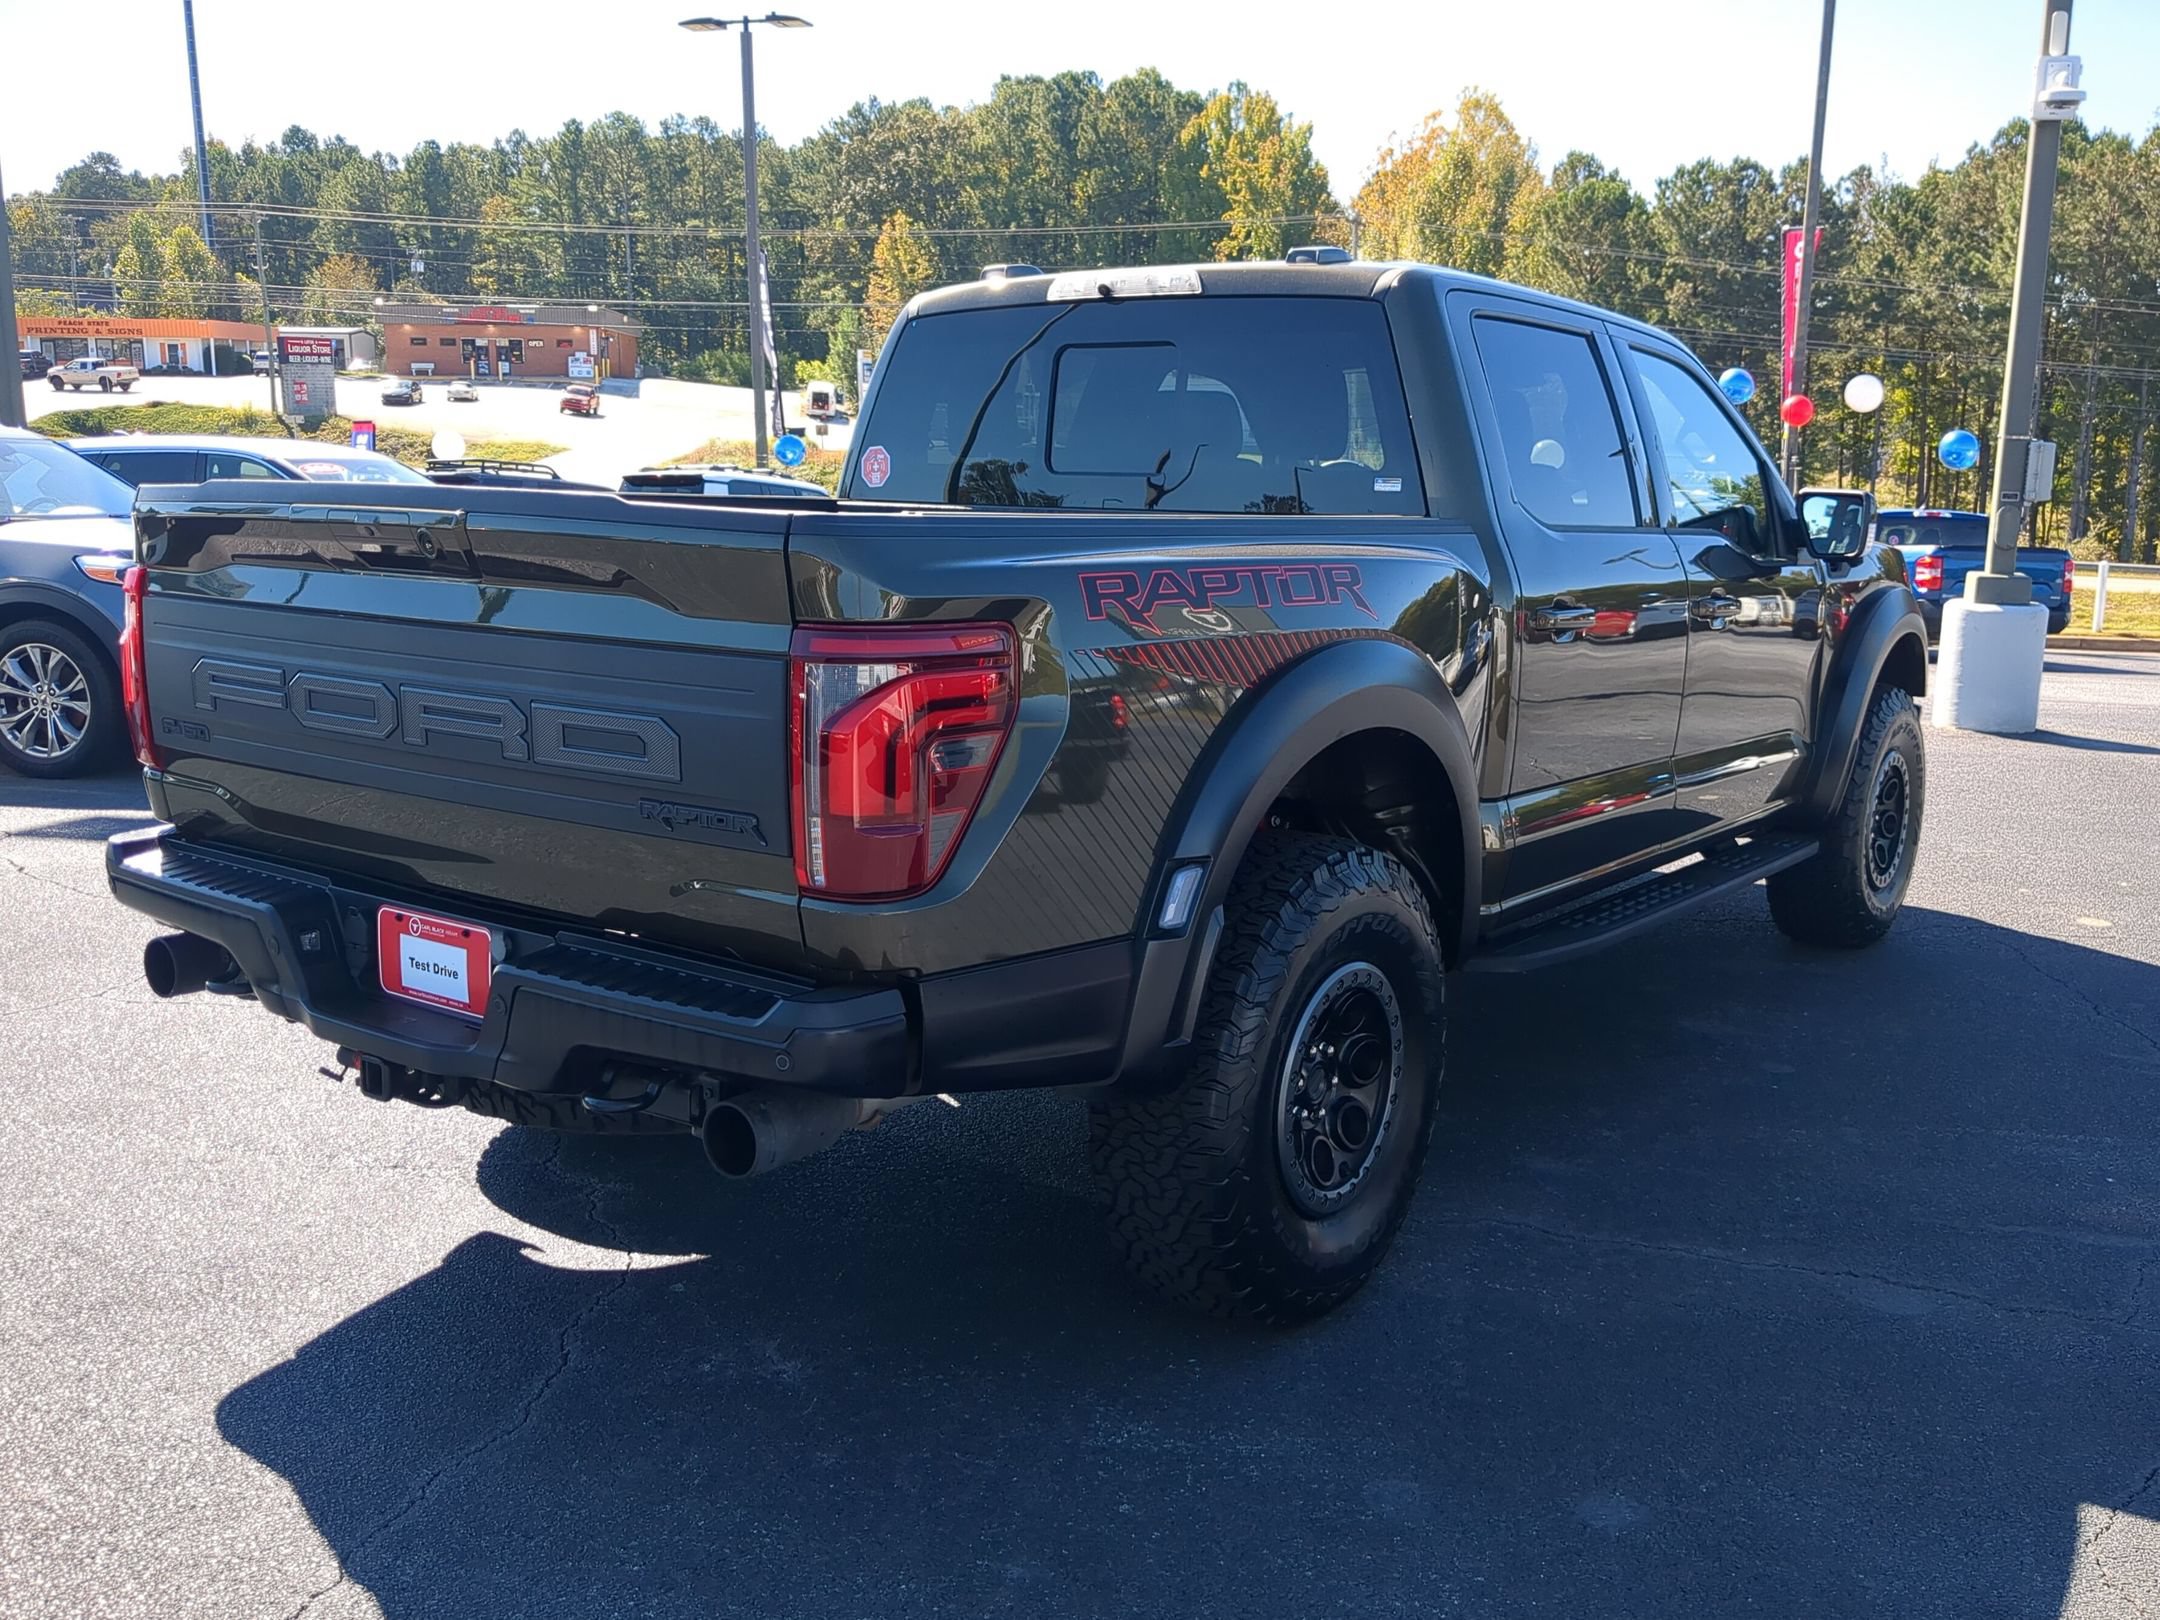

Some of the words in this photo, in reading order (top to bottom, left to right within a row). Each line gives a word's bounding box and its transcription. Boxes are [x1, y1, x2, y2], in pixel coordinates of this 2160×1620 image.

[26, 326, 89, 335] PRINTING
[107, 328, 143, 336] SIGNS
[288, 344, 311, 353] LIQUOR
[312, 345, 332, 354] STORE
[1078, 564, 1379, 636] RAPTOR
[191, 657, 683, 783] FORD
[638, 796, 769, 848] RAPTOR
[409, 956, 431, 973] Test
[433, 963, 459, 980] Drive
